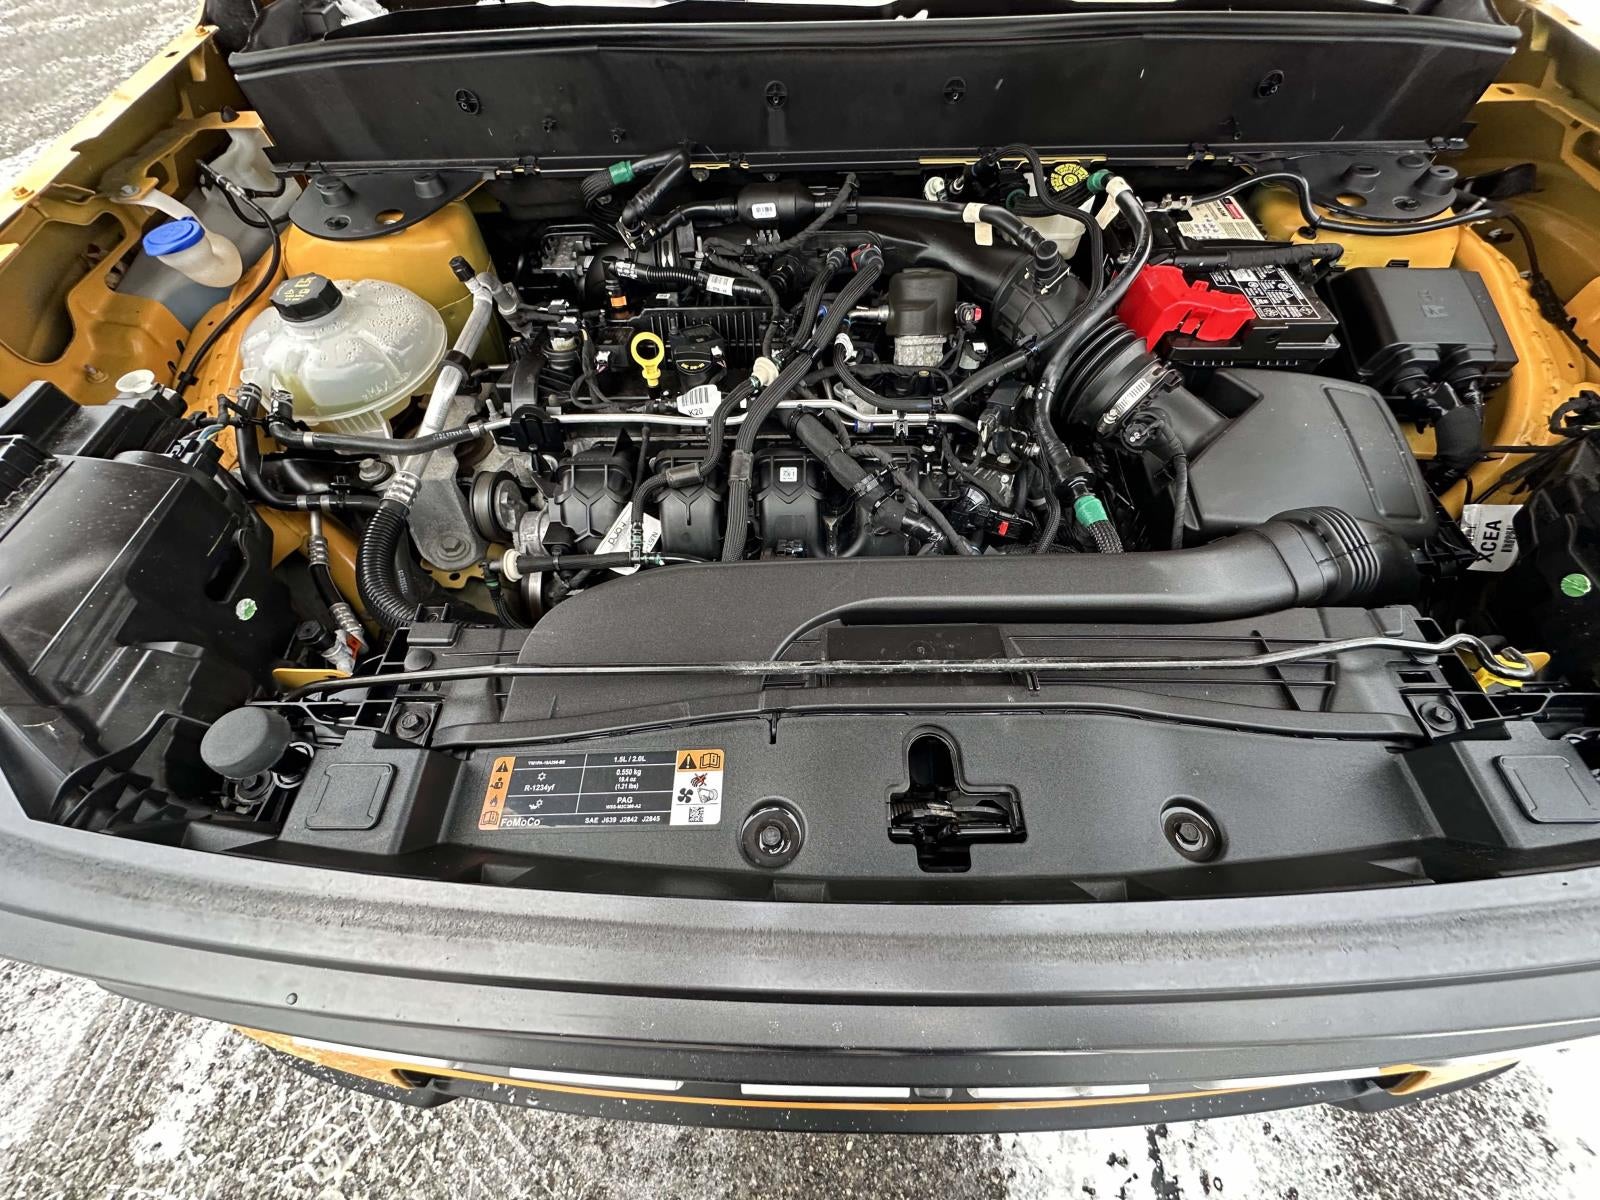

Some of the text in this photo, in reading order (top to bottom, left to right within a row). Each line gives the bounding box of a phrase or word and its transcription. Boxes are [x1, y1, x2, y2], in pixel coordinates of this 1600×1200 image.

[688, 408, 704, 416] K20
[1475, 520, 1502, 563] XCEA
[616, 768, 642, 777] 0.550 kg
[524, 783, 556, 793] R-1234yf
[617, 796, 633, 804] PAG
[500, 816, 541, 827] FoMoCo
